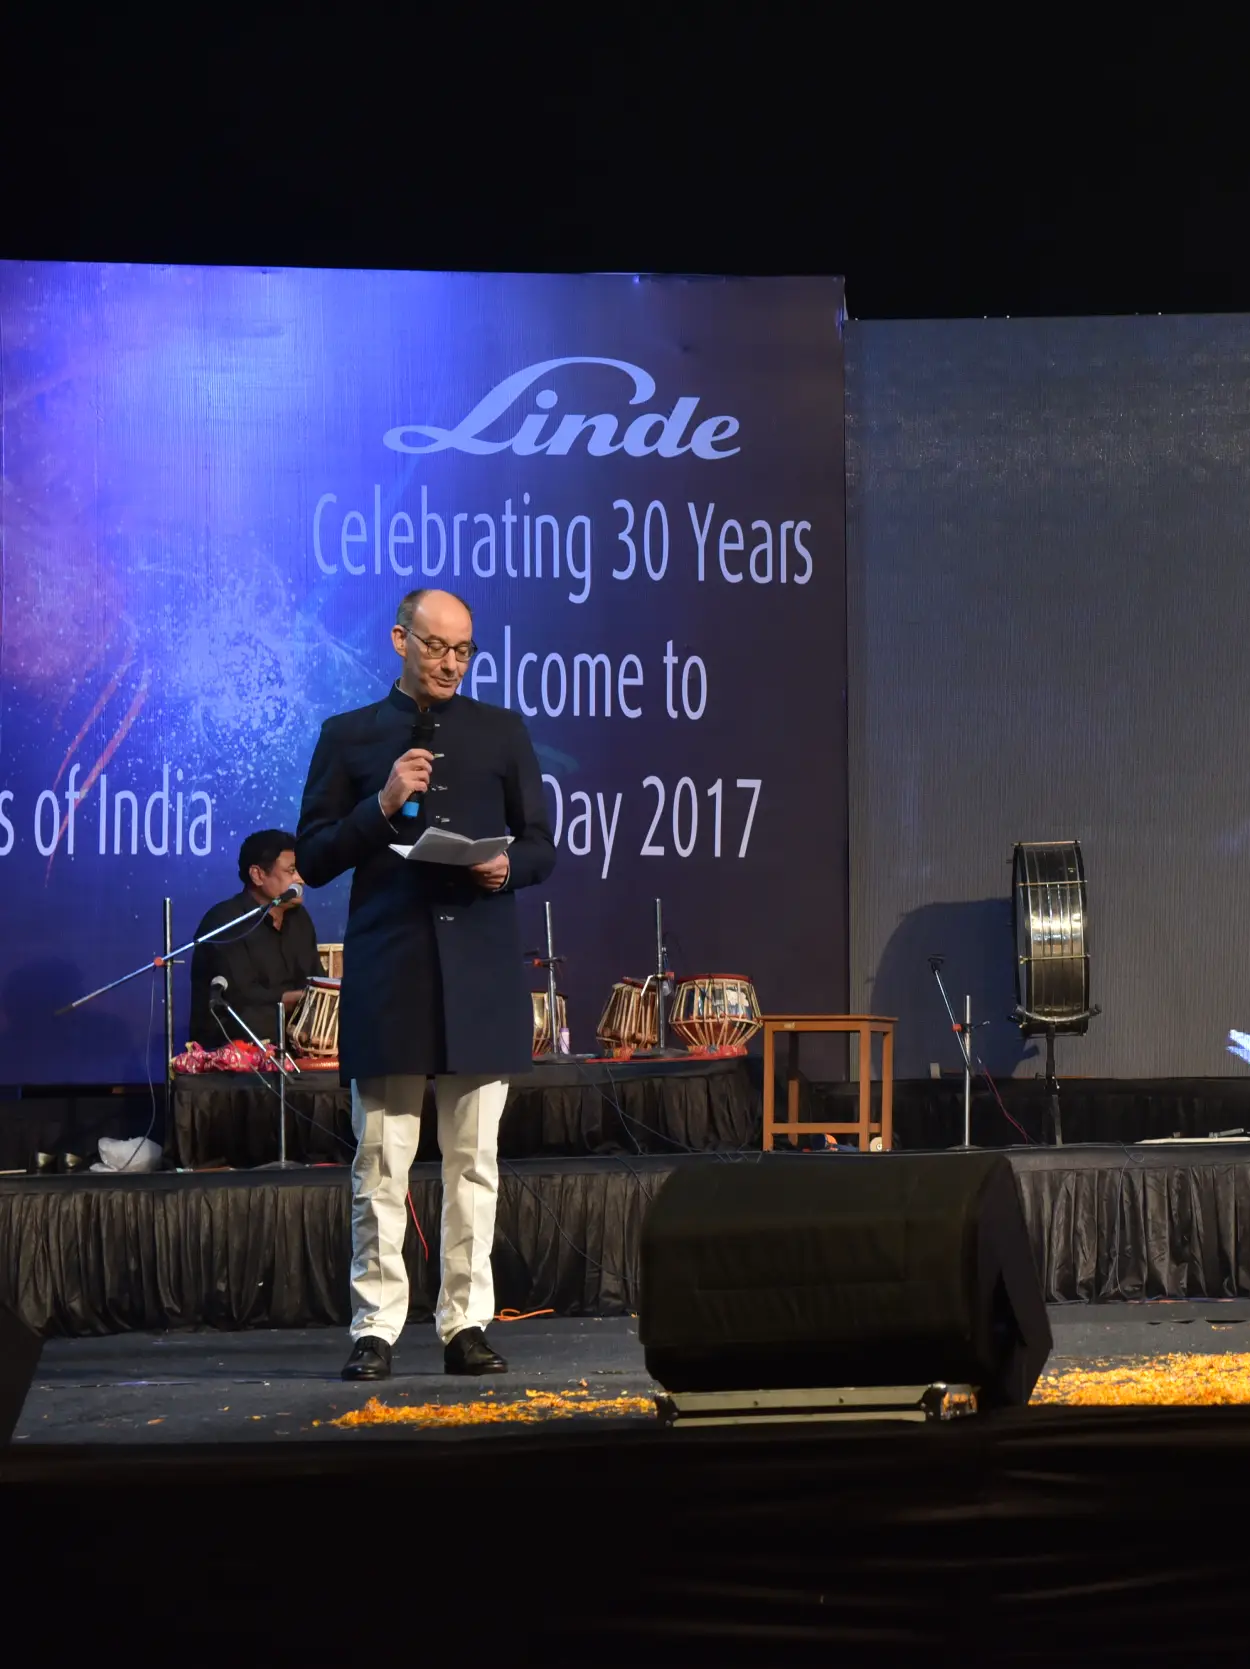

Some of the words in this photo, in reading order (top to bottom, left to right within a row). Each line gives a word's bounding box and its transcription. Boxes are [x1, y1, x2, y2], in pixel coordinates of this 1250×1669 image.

[383, 356, 742, 460] Linde
[313, 484, 592, 604] Celebrating
[612, 499, 670, 582] 30
[687, 502, 813, 584] Years
[455, 625, 643, 719] elcome
[664, 640, 708, 720] to
[34, 763, 81, 856] of
[99, 763, 212, 856] India
[640, 775, 763, 858] 2017
